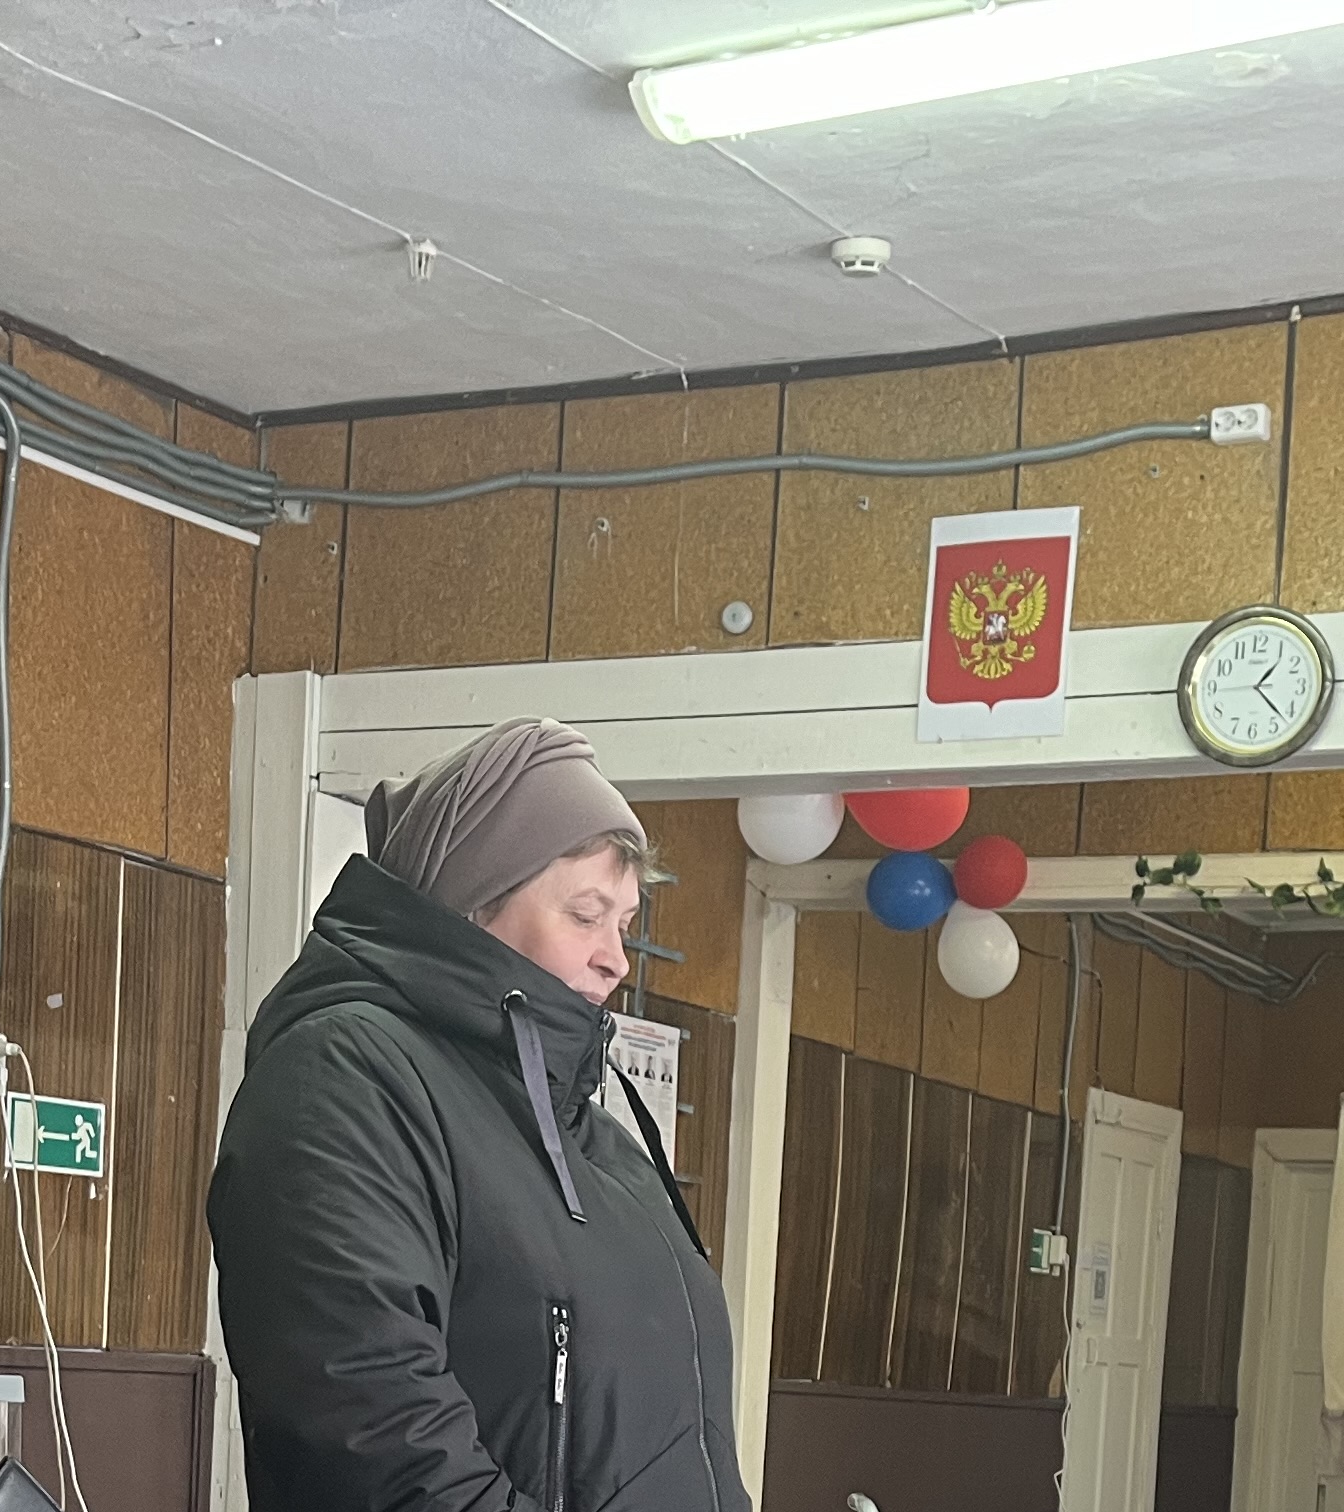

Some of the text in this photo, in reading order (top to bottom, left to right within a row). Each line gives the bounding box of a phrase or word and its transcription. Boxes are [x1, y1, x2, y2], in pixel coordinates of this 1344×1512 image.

[1235, 641, 1246, 660] 11
[1252, 635, 1269, 653] 12
[1217, 659, 1233, 677] 10
[1289, 656, 1301, 674] 2
[1207, 680, 1218, 697] 9
[1295, 678, 1306, 696] 3
[1213, 701, 1224, 719] 8
[1285, 700, 1296, 718] 4
[1230, 717, 1240, 735] 7
[1247, 723, 1258, 740] 6
[1268, 717, 1279, 734] 5
